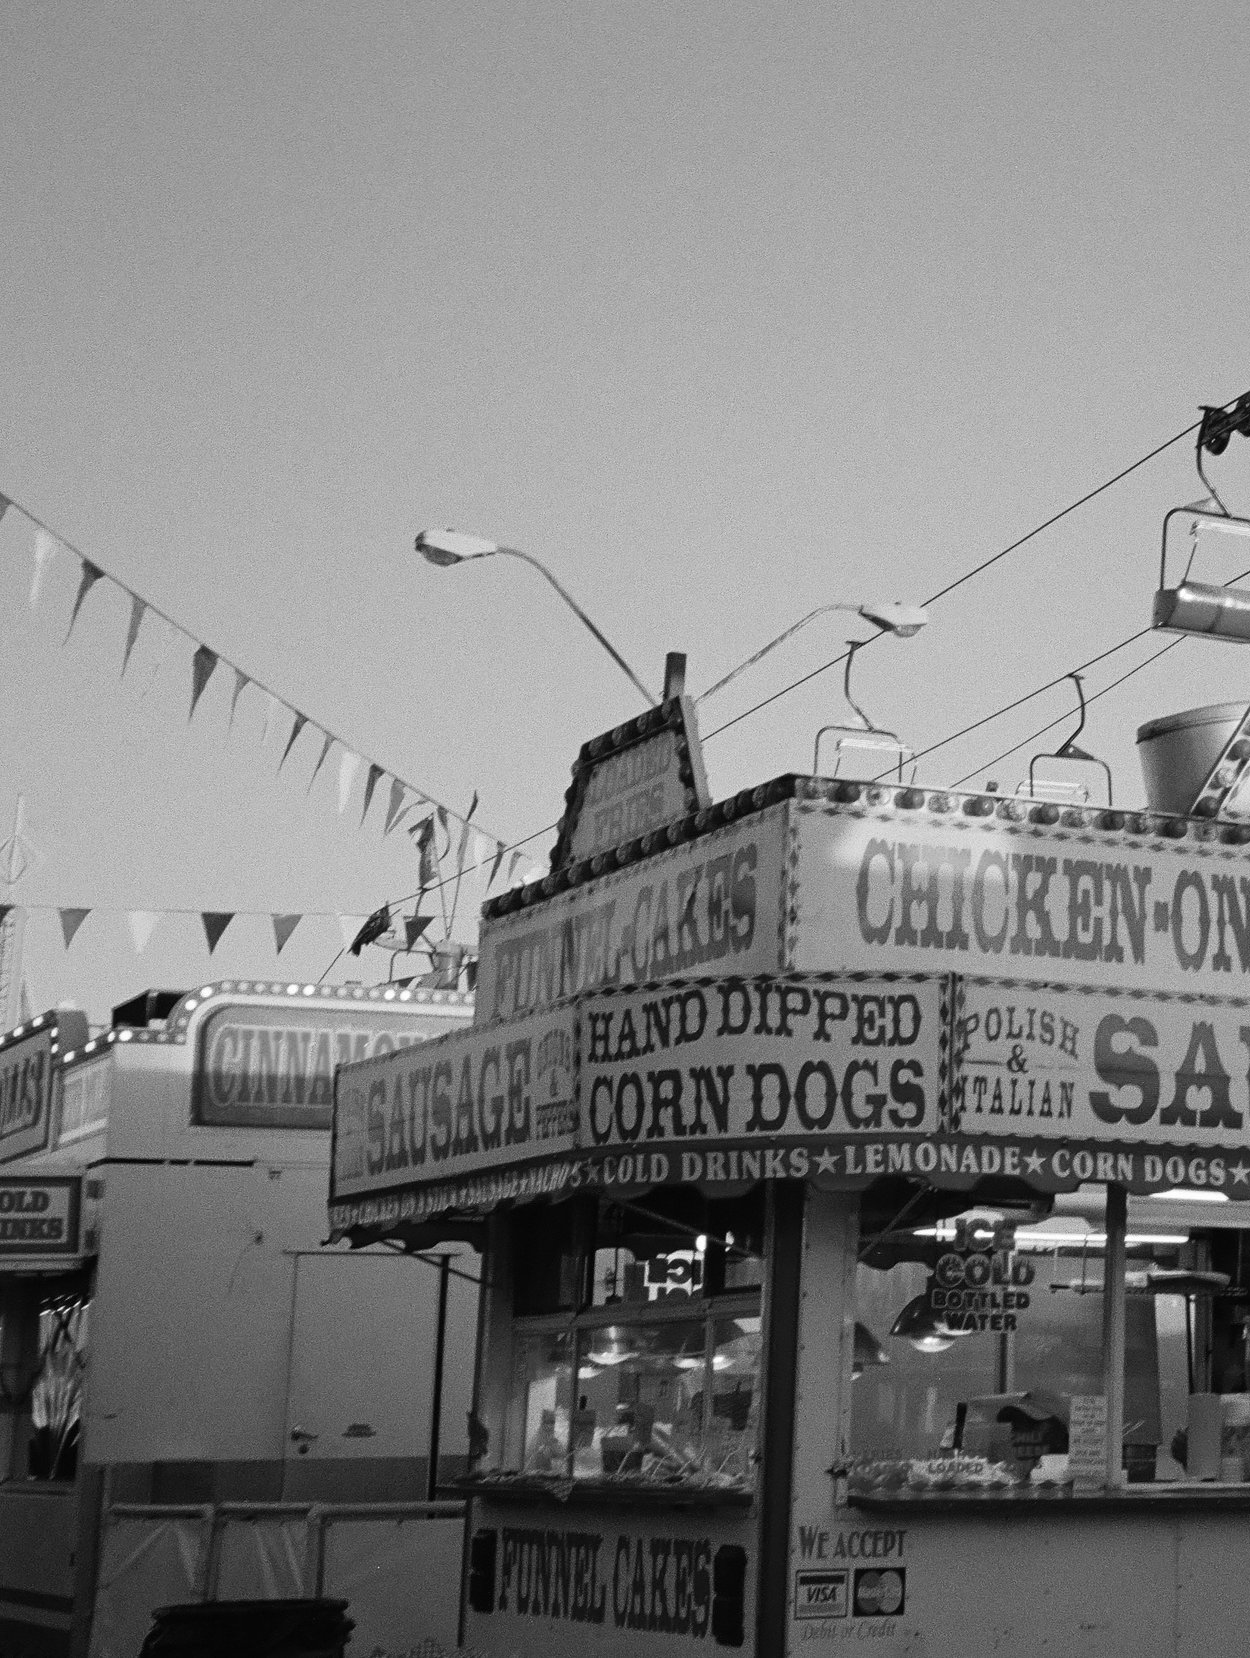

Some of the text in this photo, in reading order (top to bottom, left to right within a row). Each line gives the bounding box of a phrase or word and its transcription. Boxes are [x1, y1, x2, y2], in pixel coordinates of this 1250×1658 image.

[632, 842, 758, 984] CAKES
[588, 989, 708, 1063] HAND
[715, 983, 923, 1047] DIPPED
[958, 1006, 1079, 1060] POLISH
[1007, 1044, 1029, 1073] &
[367, 1037, 532, 1177] SAUSAGE
[589, 1064, 735, 1146] CORN
[745, 1058, 926, 1132] DOGS
[959, 1075, 1075, 1119] ITALIAN
[603, 1152, 670, 1186] COLD
[681, 1148, 810, 1182] DRINKS
[844, 1141, 1022, 1176] LEMONADE
[1051, 1149, 1134, 1181] CORN
[1143, 1155, 1227, 1187] DOGS
[0, 1190, 50, 1212] OLD
[936, 1253, 1036, 1288] COLD
[931, 1288, 1031, 1310] BOTTLED
[942, 1310, 1018, 1332] WATER
[832, 1529, 908, 1559] ACCEPT
[499, 1526, 711, 1640] FUNNEL CAKES
[806, 1587, 838, 1603] VISA
